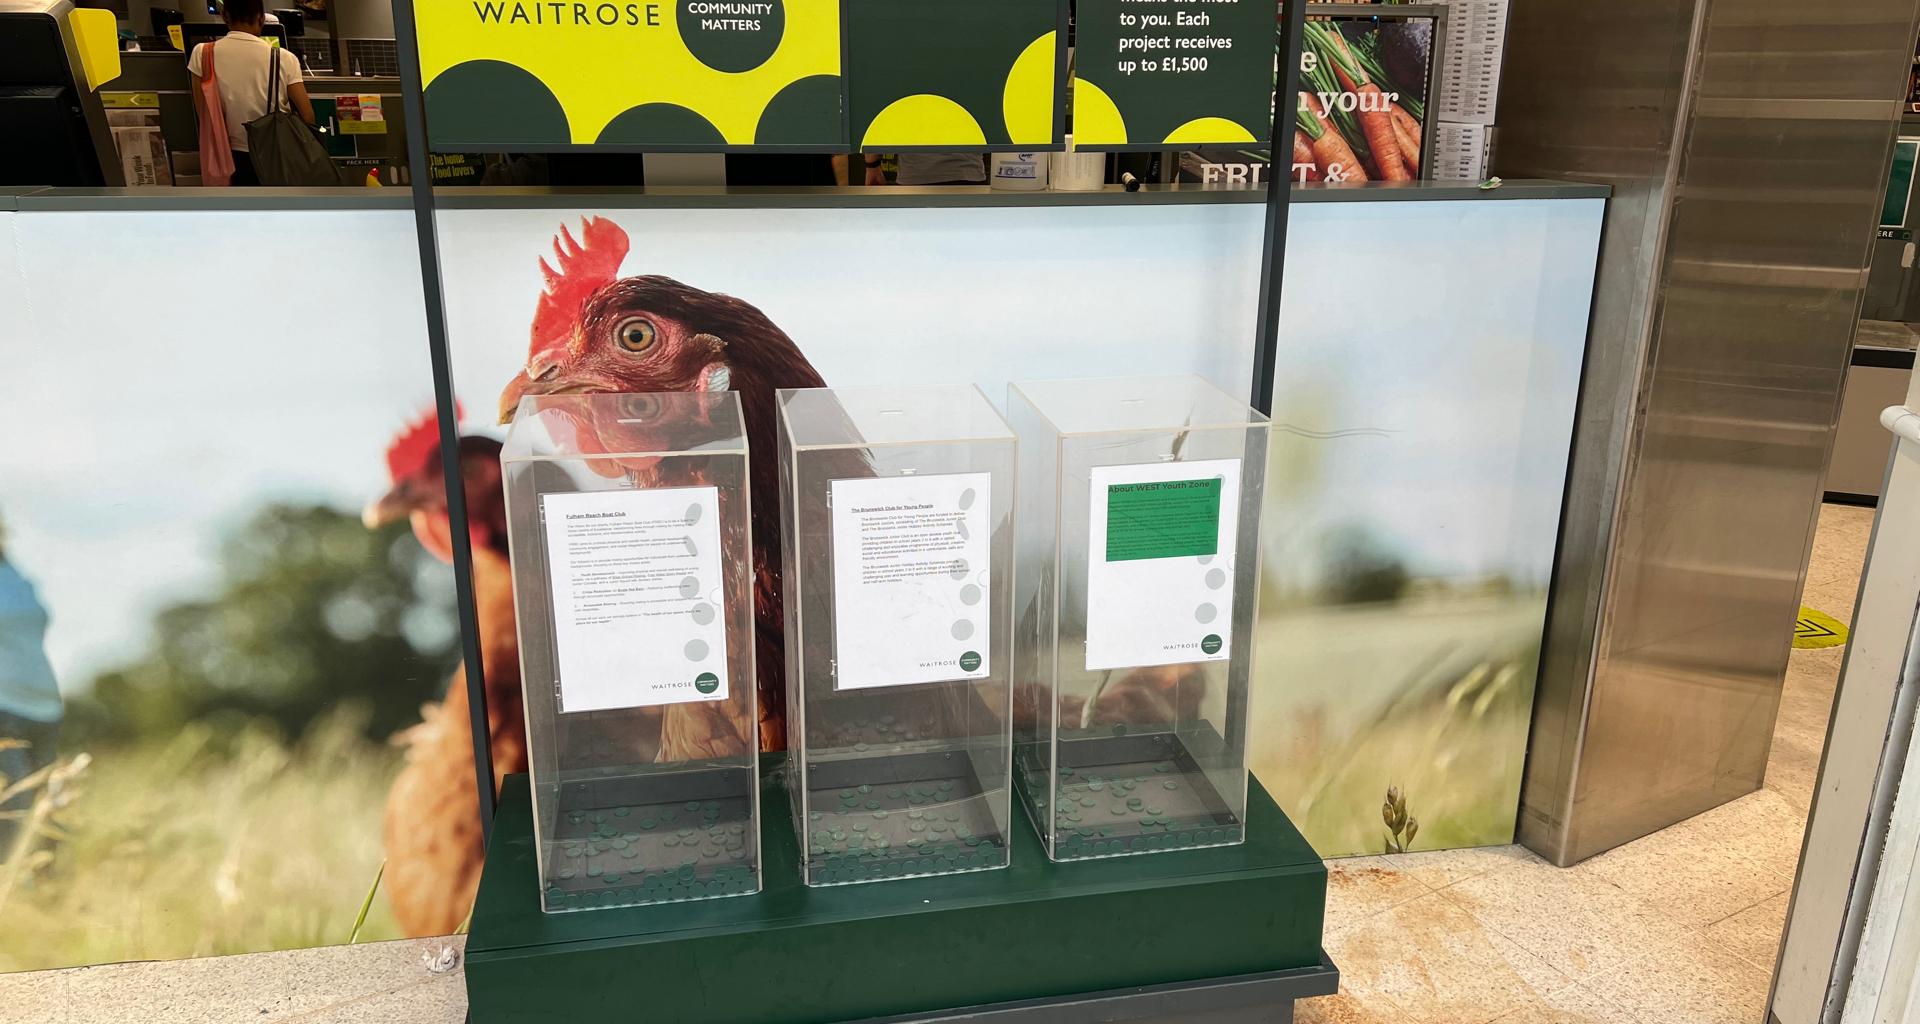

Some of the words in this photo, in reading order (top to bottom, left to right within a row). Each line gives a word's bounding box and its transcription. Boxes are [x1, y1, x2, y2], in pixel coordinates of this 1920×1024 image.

[473, 1, 660, 26] WAITROSE
[688, 2, 773, 15] COMMUNITY
[701, 19, 761, 31] MATTERS
[1119, 12, 1137, 26] to
[1140, 14, 1171, 30] you.
[1176, 11, 1210, 26] Each
[1119, 35, 1171, 52] project
[1175, 35, 1233, 49] receives
[1118, 60, 1137, 75] up
[1141, 59, 1158, 72] to
[1162, 56, 1208, 73] £1,500
[1316, 90, 1400, 119] your
[443, 153, 465, 165] home
[434, 165, 452, 179] food
[451, 165, 475, 177] lovers
[1201, 163, 1316, 183] FRT
[1877, 230, 1894, 238] ERE
[1108, 485, 1134, 494] About
[1136, 483, 1161, 492] WEST
[1162, 482, 1187, 490] Youth
[1188, 481, 1210, 489] Zone
[1163, 642, 1199, 650] WAITROSE
[919, 660, 957, 668] WAITROSE
[651, 681, 693, 690] WAITROSE
